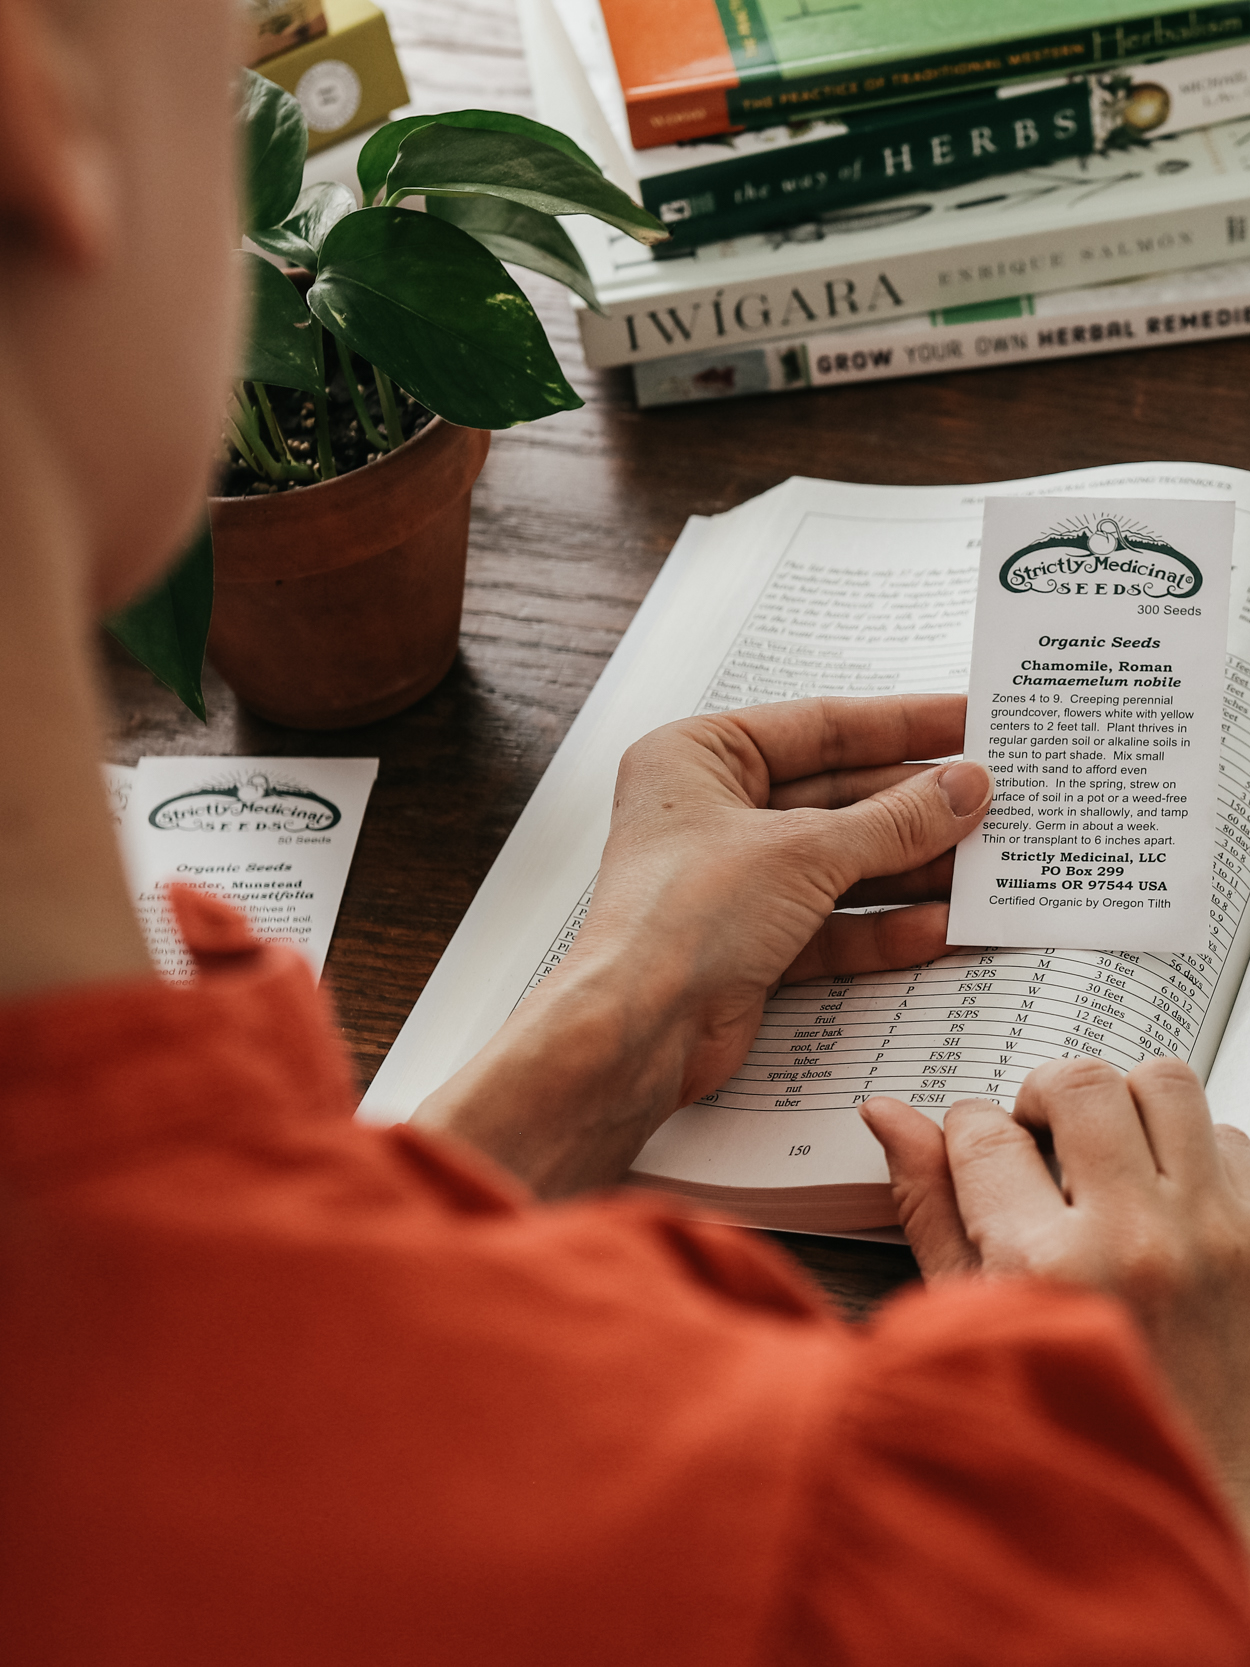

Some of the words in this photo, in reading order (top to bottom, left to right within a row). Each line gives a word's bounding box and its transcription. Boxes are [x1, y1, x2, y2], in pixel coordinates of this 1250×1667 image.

[734, 182, 769, 204] the
[781, 171, 828, 194] way
[839, 157, 863, 183] of
[882, 109, 1079, 178] HERBS
[623, 272, 906, 352] IWÍGARA
[937, 251, 1064, 287] ENRIQUE
[816, 348, 893, 375] GROW
[902, 339, 963, 364] YOUR
[974, 333, 1029, 356] OWN
[1038, 319, 1135, 349] HERBAL
[1010, 558, 1087, 585] Strictly
[1057, 583, 1142, 596] SEEDS
[1137, 605, 1159, 615] 300
[1164, 605, 1201, 616] Seeds
[1039, 635, 1105, 650] Organic
[1111, 636, 1160, 648] Seeds
[1021, 660, 1112, 673] Chamomile,
[1119, 661, 1172, 672] Roman
[1013, 675, 1128, 687] Chamaemelum
[1134, 676, 1181, 687] nobile
[992, 694, 1026, 703] Zones
[1029, 694, 1036, 703] 4
[1040, 694, 1050, 703] to
[1053, 694, 1063, 703] 9.
[1070, 695, 1119, 706] Creeping
[1123, 695, 1173, 706] perennial
[991, 708, 1060, 720] groundcover,
[1064, 708, 1101, 718] flowers
[1105, 709, 1132, 718] white
[1136, 709, 1157, 719] with
[1160, 709, 1194, 720] yellow
[990, 722, 1030, 731] centers
[1034, 722, 1043, 731] to
[1047, 722, 1054, 731] 2
[1057, 722, 1078, 731] feet
[1081, 722, 1100, 732] tall.
[1107, 723, 1135, 732] Plant
[1138, 723, 1174, 733] thrives
[1178, 724, 1187, 733] in
[156, 803, 231, 828] Strictly
[296, 836, 331, 845] Seeds
[1001, 851, 1055, 864] Strictly
[1060, 852, 1133, 864] Medicinal,
[1139, 853, 1167, 862] LLC
[177, 863, 240, 875] Organic
[245, 862, 292, 872] Seeds
[1041, 866, 1061, 876] PO
[1066, 867, 1092, 876] Box
[1097, 867, 1124, 877] 299
[232, 880, 302, 889] Munstead
[996, 879, 1056, 889] Williams
[1061, 880, 1082, 890] OR
[1088, 880, 1133, 891] 97544
[1139, 881, 1167, 891] USA
[222, 891, 314, 902] angustifolia
[989, 896, 1035, 906] Certified
[1038, 896, 1082, 909] Organic
[1086, 897, 1098, 909] by
[1102, 898, 1144, 910] Oregon
[1148, 898, 1171, 908] Tilth
[1097, 957, 1112, 967] 30
[1115, 963, 1135, 976] feet
[964, 969, 996, 979] FS/PS
[1095, 971, 1102, 979] 3
[1105, 974, 1126, 988] feet
[827, 989, 849, 997] leaf
[958, 983, 992, 992] FS/SH
[1086, 983, 1100, 993] 30
[1103, 988, 1124, 1003] feet
[820, 1002, 842, 1010] seed
[962, 996, 976, 1005] FS
[1074, 995, 1088, 1004] 19
[1091, 999, 1125, 1018] inches
[813, 1015, 836, 1024] fruit
[947, 1010, 979, 1019] FS/PS
[1076, 1010, 1089, 1020] 12
[1092, 1015, 1113, 1029] feet
[794, 1029, 819, 1037] inner
[822, 1028, 844, 1037] bark
[949, 1024, 964, 1032] PS
[1083, 1026, 1104, 1041] feet
[790, 1042, 812, 1052] root,
[815, 1041, 837, 1051] leaf
[943, 1037, 960, 1046] SH
[794, 1057, 819, 1065] tuber
[929, 1051, 962, 1060] FS/PS
[767, 1070, 799, 1080] spring
[801, 1069, 832, 1078] shoots
[922, 1065, 957, 1074] PS/SH
[921, 1079, 946, 1088] S/PS
[774, 1098, 801, 1107] tuber
[910, 1094, 945, 1102] FS/SH
[789, 1145, 810, 1156] 150
